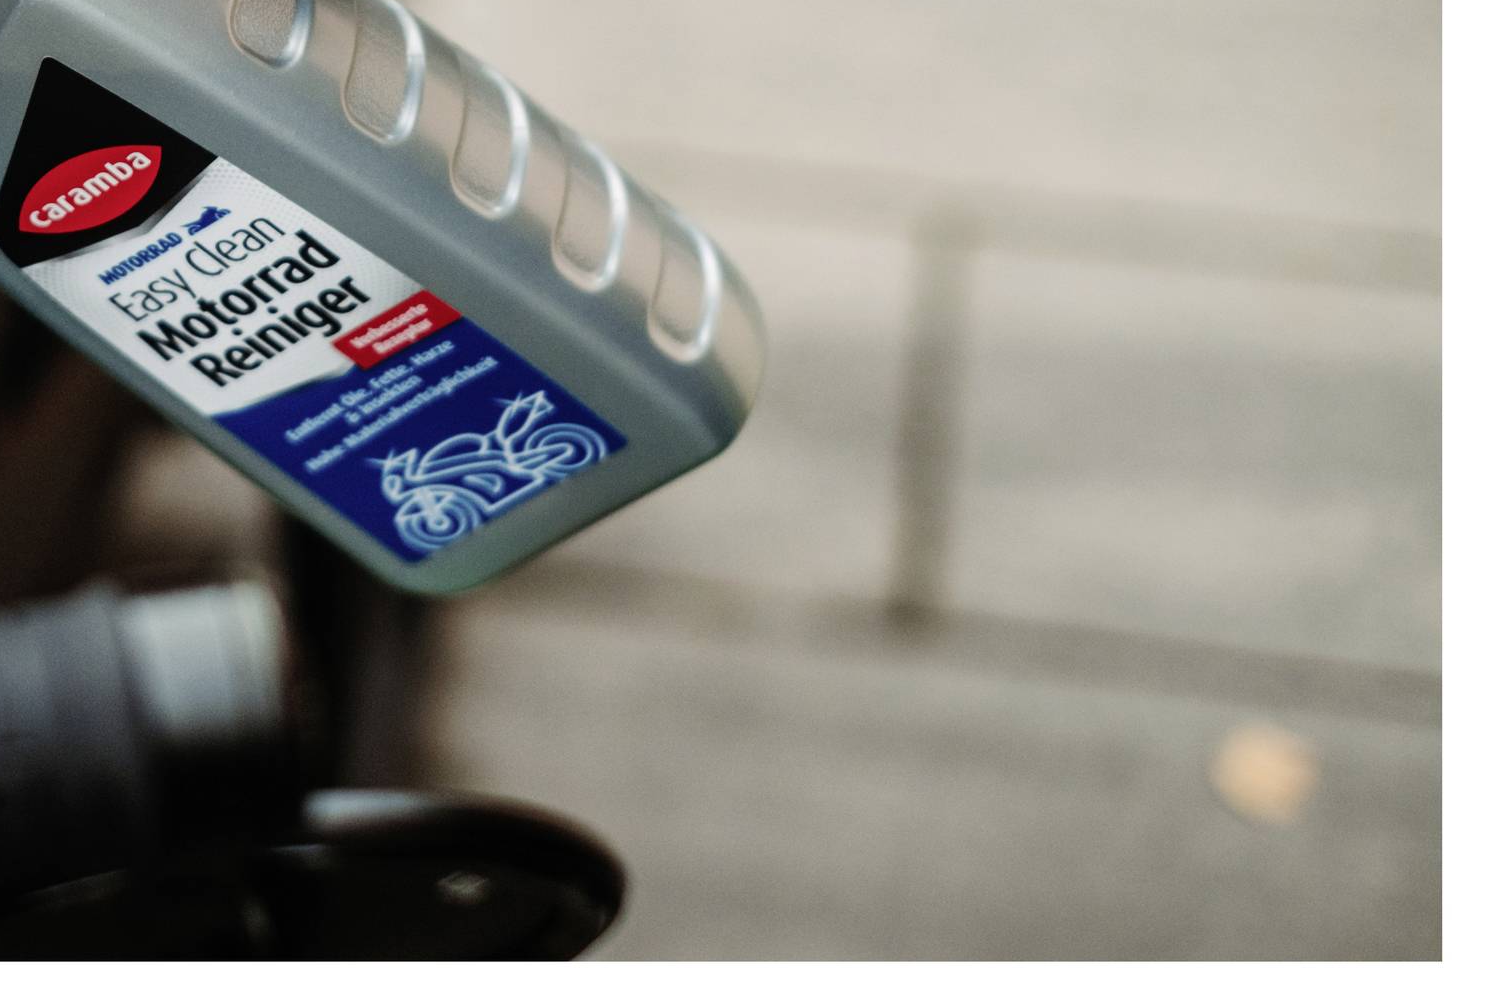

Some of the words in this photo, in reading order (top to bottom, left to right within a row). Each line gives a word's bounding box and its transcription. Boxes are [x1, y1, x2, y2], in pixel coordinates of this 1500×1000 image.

[29, 151, 151, 228] caramba
[98, 232, 183, 285] MOTORRAD
[108, 268, 195, 322] Easy
[185, 216, 286, 277] Clean
[137, 229, 340, 361] Motorrad
[190, 276, 371, 387] Reiniger
[350, 303, 428, 349] Verbesserte
[372, 318, 433, 354] Rezeptur
[285, 403, 345, 443] Entfernt
[369, 363, 414, 390] Fette,
[409, 339, 455, 367] Harze
[358, 374, 423, 416] Insekten
